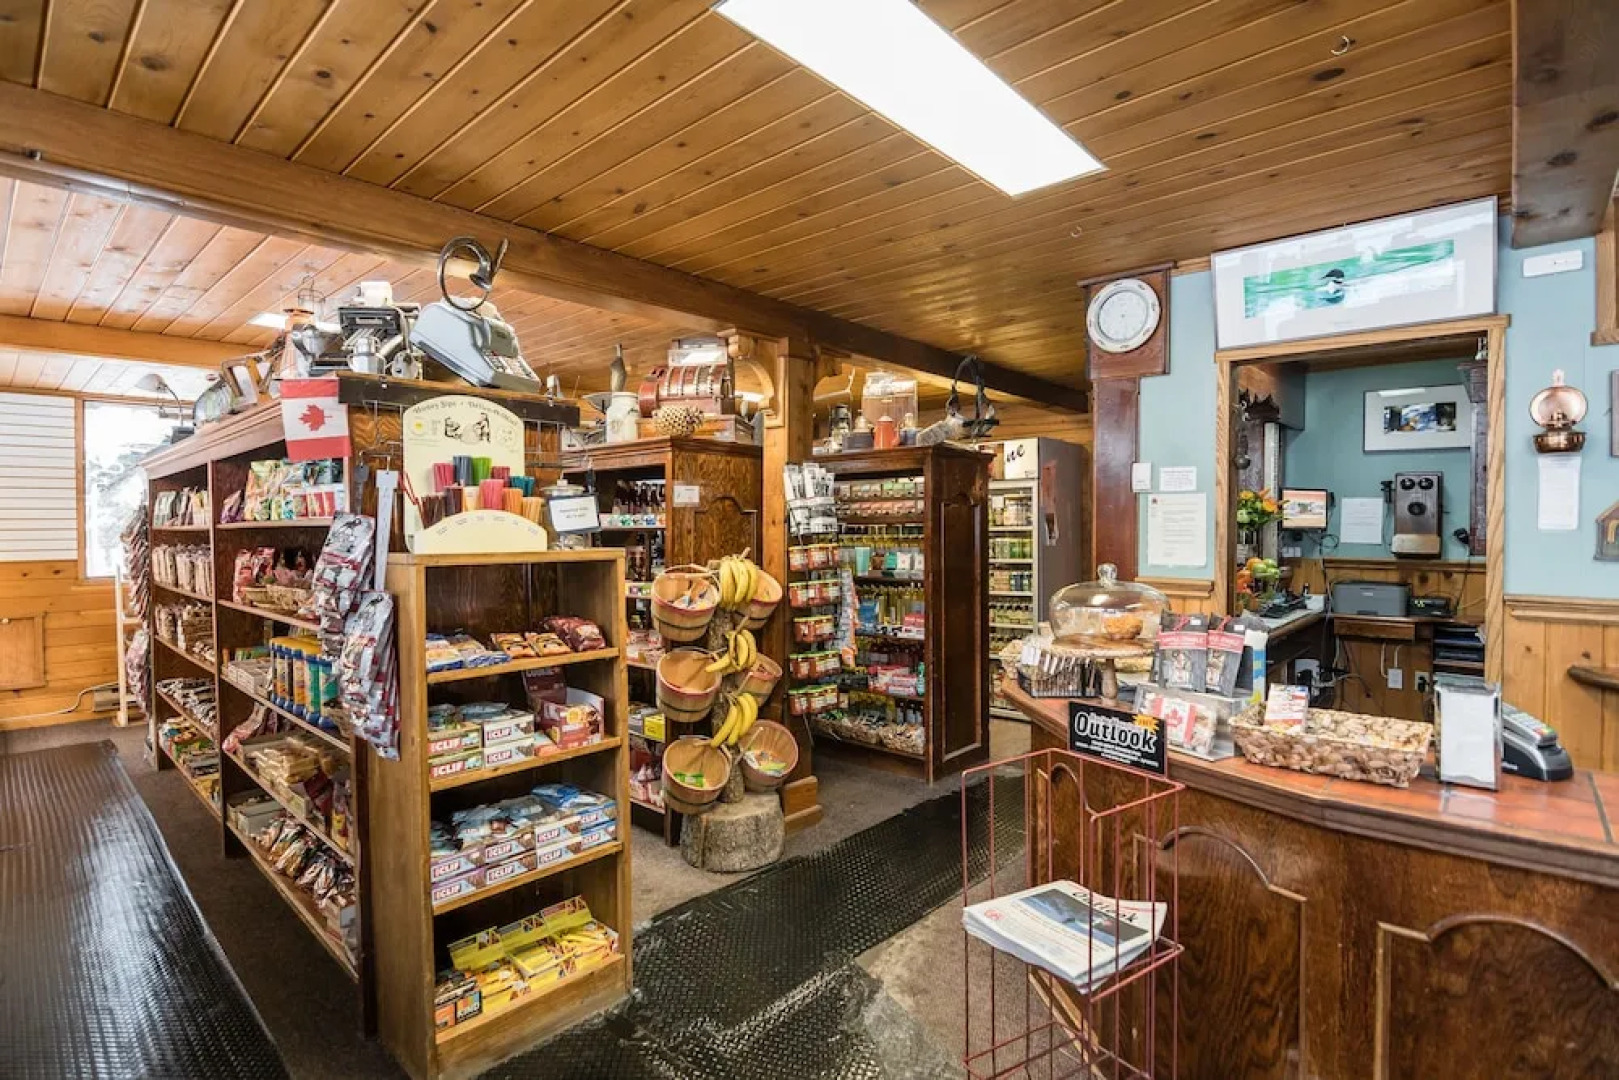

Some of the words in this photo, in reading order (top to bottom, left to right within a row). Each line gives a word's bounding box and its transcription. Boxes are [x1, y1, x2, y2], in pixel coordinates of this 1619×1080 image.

[1074, 711, 1158, 754] Outlook
[435, 738, 460, 750] CLIF
[438, 761, 463, 775] CLIF
